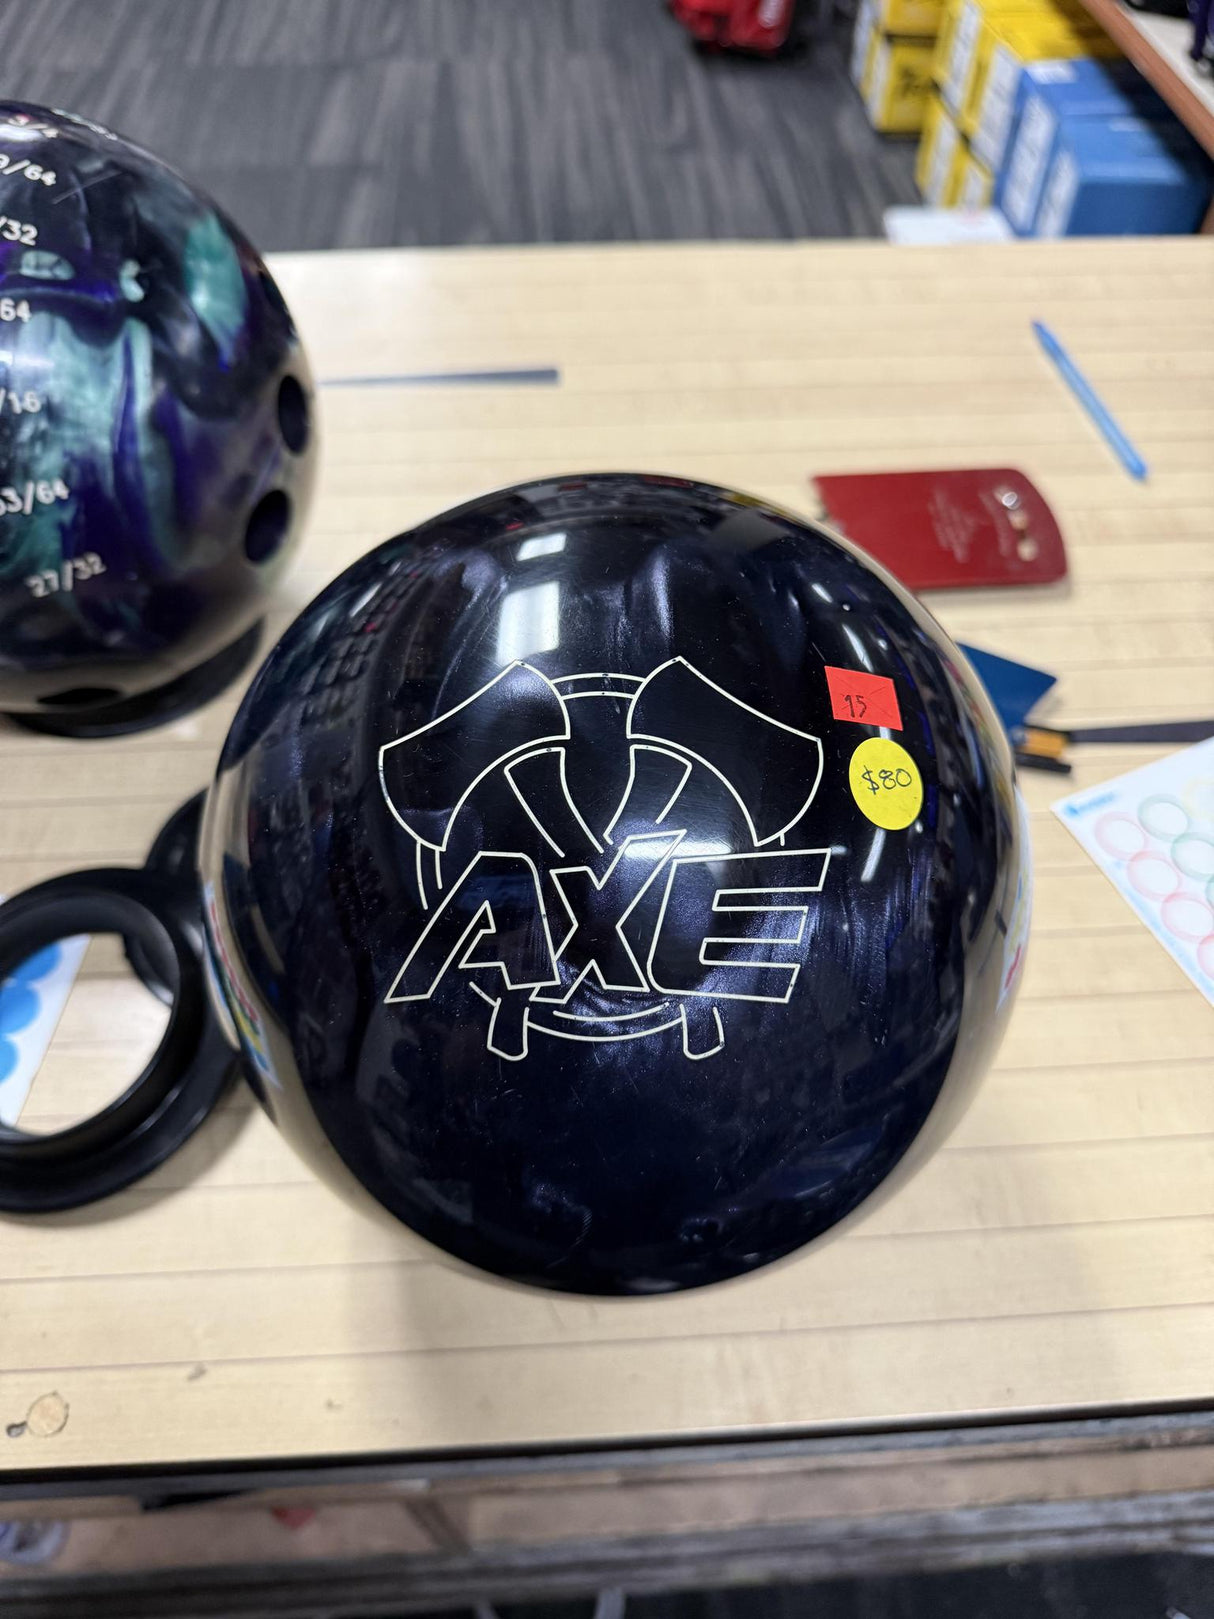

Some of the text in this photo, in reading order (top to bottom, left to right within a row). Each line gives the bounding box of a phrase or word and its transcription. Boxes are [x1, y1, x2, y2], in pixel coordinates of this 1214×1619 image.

[25, 551, 107, 598] 27/32
[861, 764, 913, 796] $80
[384, 828, 832, 1004] AXE
